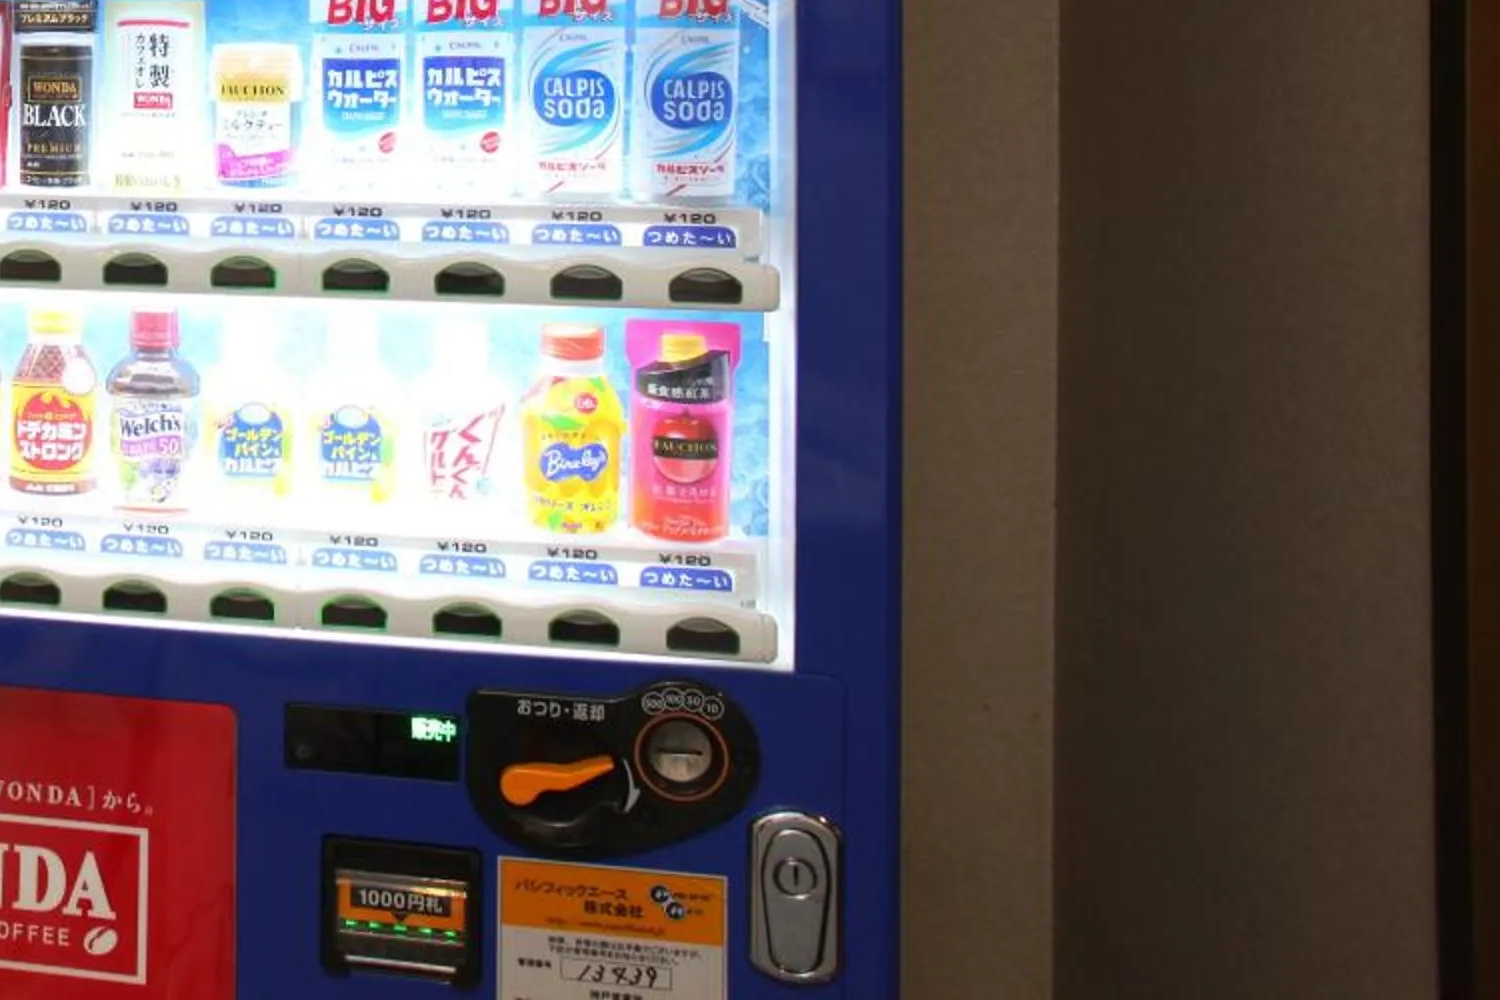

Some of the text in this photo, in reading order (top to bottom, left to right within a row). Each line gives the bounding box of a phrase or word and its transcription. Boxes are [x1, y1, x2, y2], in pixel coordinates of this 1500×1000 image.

[327, 68, 398, 89] カルピス
[427, 66, 501, 88] カルピス
[33, 80, 78, 94] WONDA
[543, 76, 605, 98] CALPIS
[663, 78, 725, 100] CALPIS
[22, 104, 86, 127] BLACK
[24, 199, 71, 211] ¥120
[130, 201, 178, 213] ¥120
[234, 202, 283, 214] ¥120
[333, 205, 383, 218] ¥120
[441, 207, 492, 220] ¥120
[551, 209, 603, 222] ¥120
[664, 212, 717, 225] ¥120
[121, 414, 182, 437] Welch's
[18, 515, 63, 528] ¥120
[123, 523, 169, 535] ¥120
[226, 529, 273, 542] ¥120
[329, 535, 378, 547] ¥120
[437, 540, 487, 553] ¥120
[547, 547, 597, 560] ¥120
[659, 553, 711, 567] ¥120
[517, 700, 606, 722] おつり・返却
[410, 717, 457, 743] 販売中
[358, 886, 444, 916] 1000円札
[583, 900, 645, 919] 株式会社
